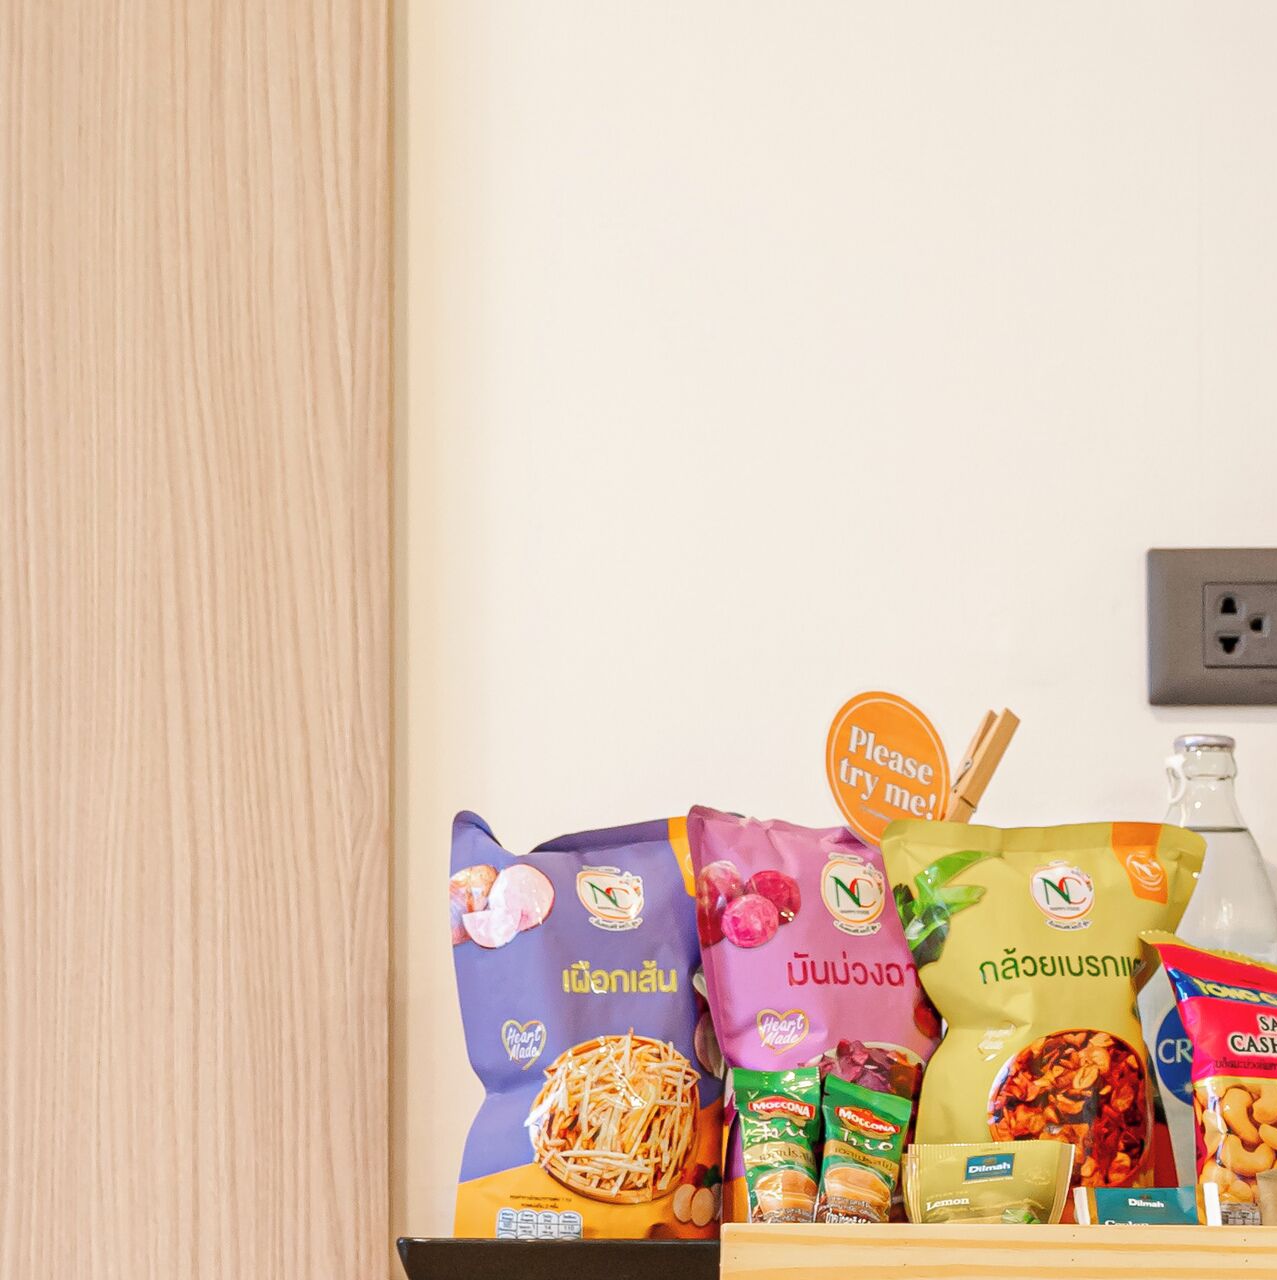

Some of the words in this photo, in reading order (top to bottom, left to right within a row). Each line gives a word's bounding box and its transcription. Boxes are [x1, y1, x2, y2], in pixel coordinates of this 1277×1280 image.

[848, 725, 934, 785] Please
[839, 757, 879, 801] try
[884, 783, 937, 821] me!
[562, 959, 678, 994] เผือกเส้น
[763, 1014, 805, 1032] Heart
[507, 1026, 542, 1045] Heart
[761, 1027, 799, 1048] Made
[509, 1038, 539, 1061] Made
[841, 1126, 894, 1151] Trio
[967, 1161, 1011, 1174] Dilmah
[926, 1197, 970, 1212] Lemon
[1127, 1198, 1165, 1209] Dilmah
